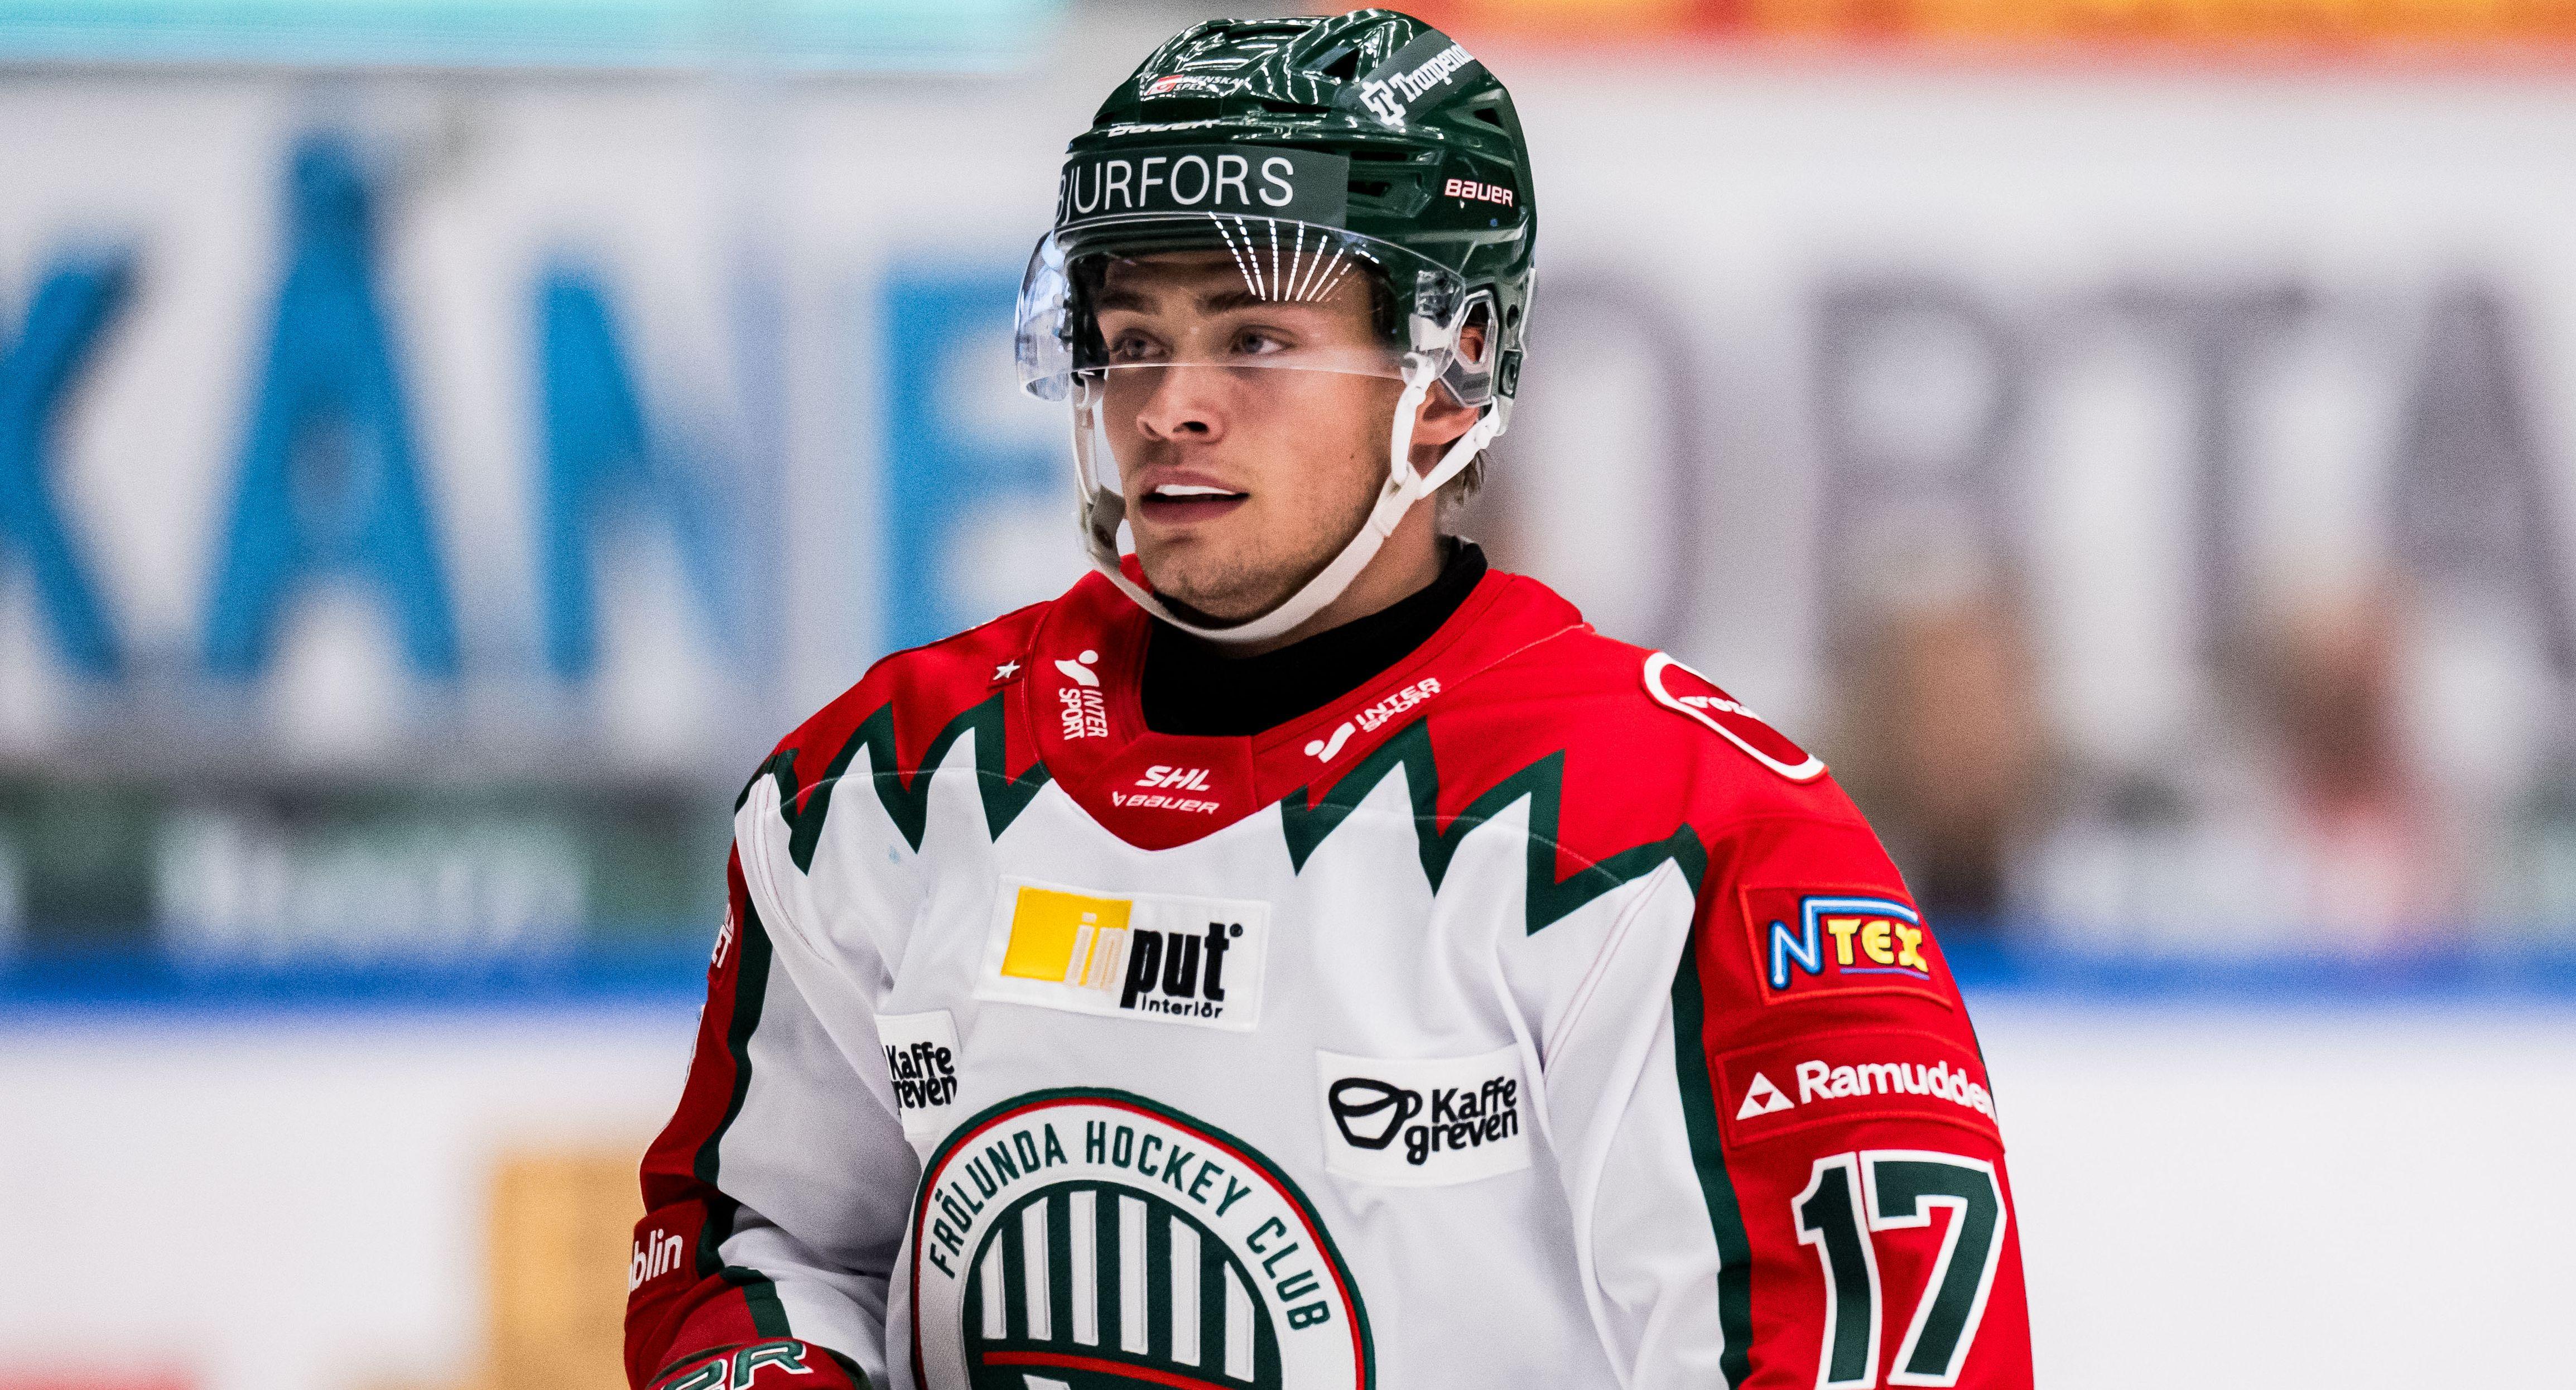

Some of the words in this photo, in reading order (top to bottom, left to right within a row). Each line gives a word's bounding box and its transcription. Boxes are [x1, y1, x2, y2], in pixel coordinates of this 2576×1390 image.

[1445, 178, 1513, 208] BAUER
[1058, 687, 1085, 740] SPORT
[1082, 689, 1109, 738] INTER
[1355, 677, 1441, 726] INTER
[1134, 764, 1211, 792] SHL
[1125, 793, 1220, 815] BAUER
[885, 1041, 955, 1080] Kaffe
[891, 1075, 957, 1109] reven
[1432, 1076, 1517, 1123] Kaffe
[1404, 1108, 1518, 1166] greven
[928, 1122, 1068, 1280] FRÖLUNDA
[1086, 1120, 1252, 1218] HOCKEY
[1246, 1216, 1331, 1332] CLUB
[1791, 1149, 2007, 1390] 17
